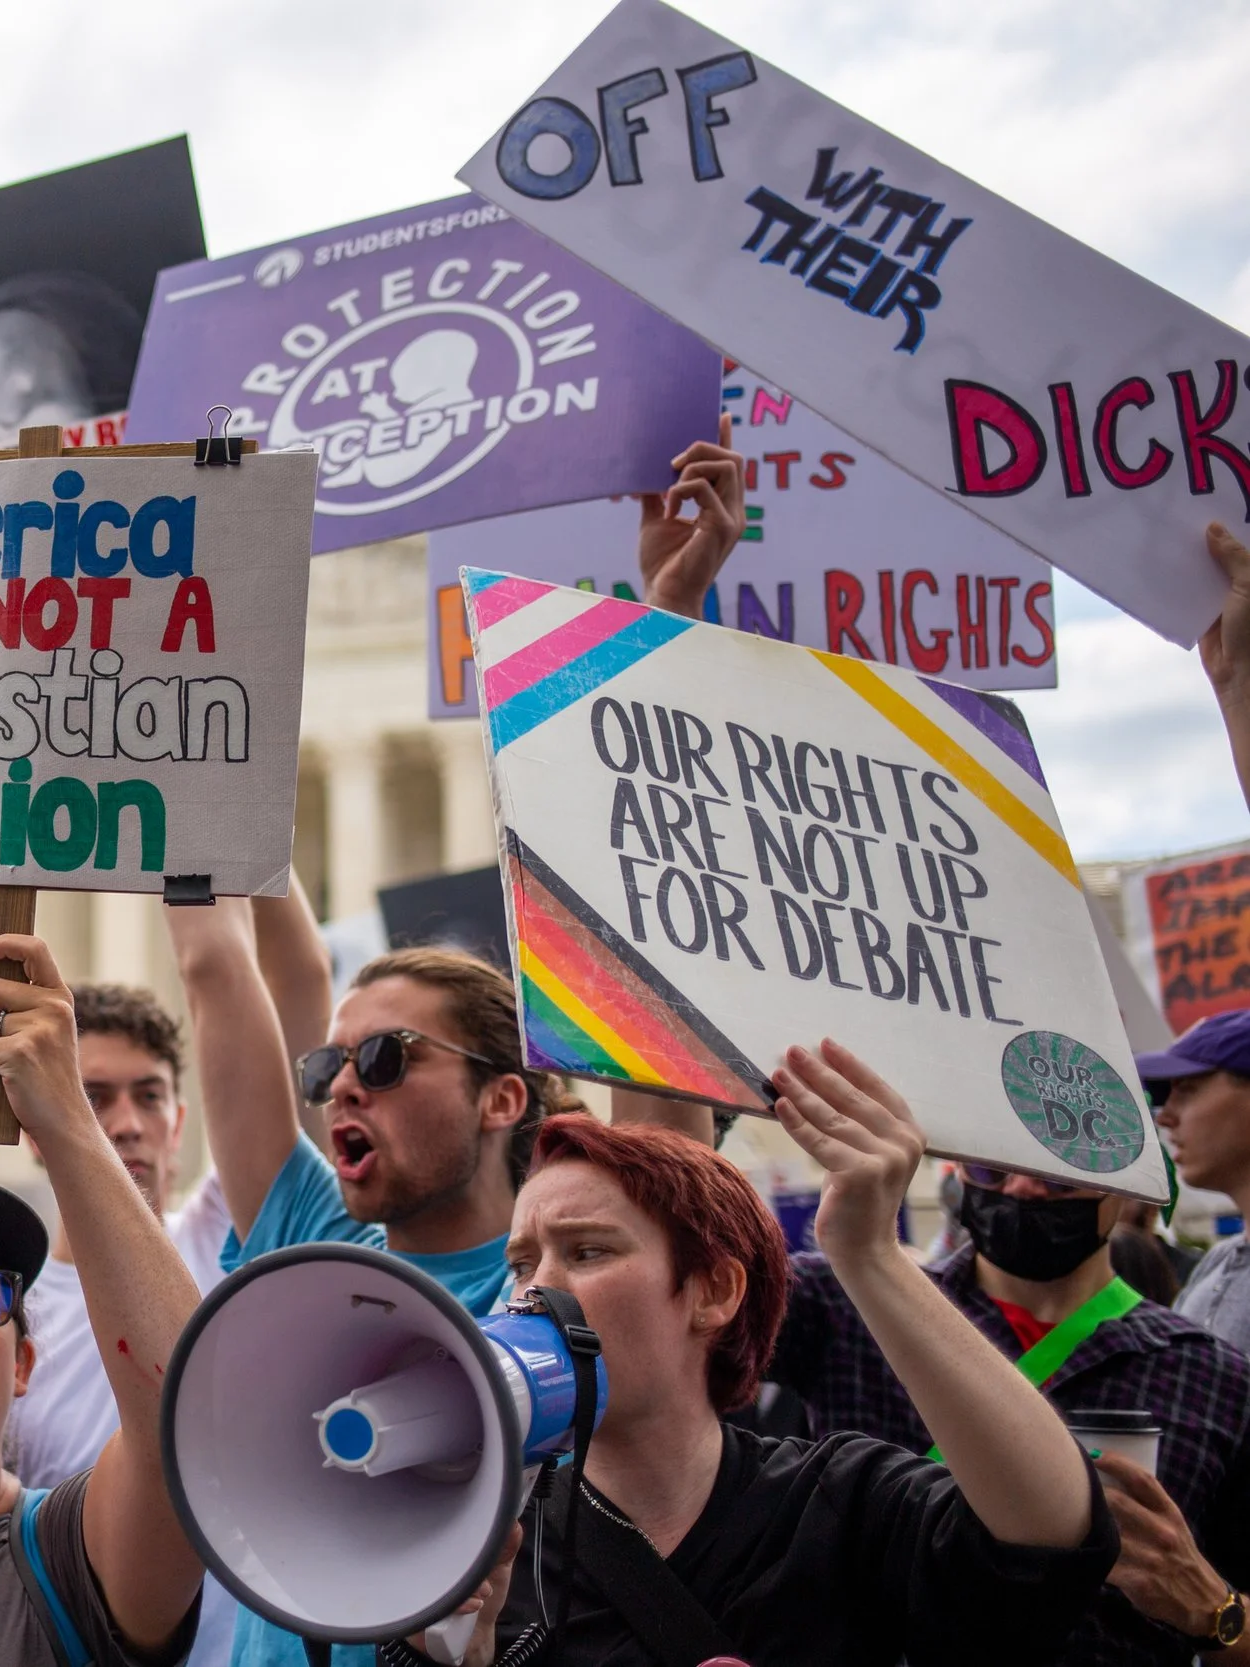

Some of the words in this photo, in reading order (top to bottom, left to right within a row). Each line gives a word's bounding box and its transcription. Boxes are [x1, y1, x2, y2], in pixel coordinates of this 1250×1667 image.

[496, 51, 758, 200] OFF
[741, 186, 944, 355] THEIR
[806, 147, 972, 276] WITH
[310, 357, 388, 404] AT
[944, 359, 1250, 523] DICK
[160, 576, 216, 653] A
[824, 568, 1056, 674] RIGHTS
[589, 696, 728, 797] OUR
[726, 721, 980, 856] RIGHTS
[610, 779, 748, 880] ARE
[745, 806, 884, 910] NOT
[902, 848, 989, 931] UP
[618, 855, 765, 971] FOR
[772, 889, 1024, 1026] DEBATE
[1027, 1055, 1099, 1091] OUR
[1033, 1078, 1108, 1110] RIGHTS
[1041, 1096, 1118, 1148] DC
